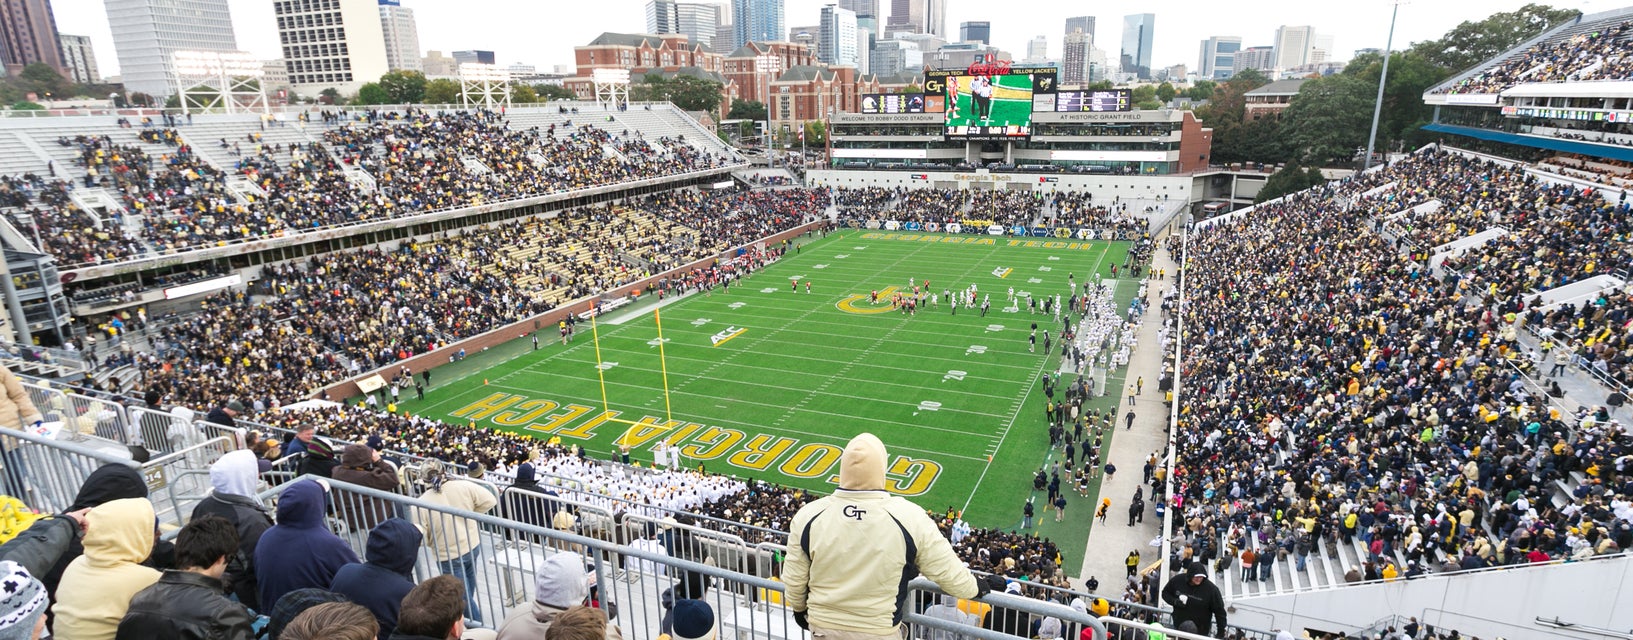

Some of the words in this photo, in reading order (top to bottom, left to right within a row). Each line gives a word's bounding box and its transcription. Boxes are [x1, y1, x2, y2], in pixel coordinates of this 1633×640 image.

[926, 80, 944, 92] GT
[954, 173, 989, 182] Georgia
[1007, 239, 1093, 250] TECH
[710, 325, 746, 345] ACC
[943, 370, 968, 381] 20
[917, 400, 942, 411] 10
[448, 391, 623, 440] TECH
[611, 415, 943, 497] GORGIA
[843, 505, 867, 521] GT
